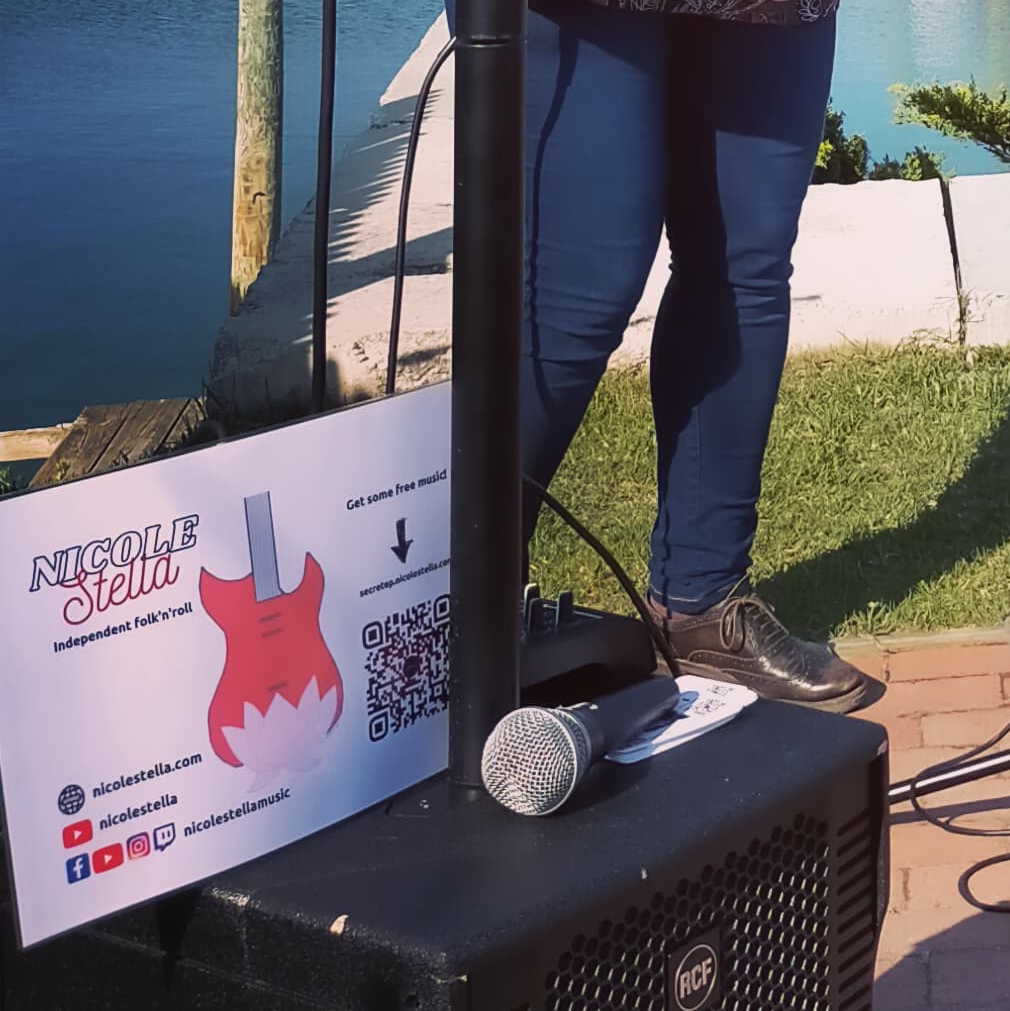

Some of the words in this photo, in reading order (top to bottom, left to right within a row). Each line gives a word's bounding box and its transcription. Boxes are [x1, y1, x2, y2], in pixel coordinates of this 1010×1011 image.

[346, 496, 365, 510] Get
[367, 489, 394, 505] some
[395, 481, 416, 496] free
[29, 514, 199, 592] NICOLE
[59, 553, 180, 626] Stella
[53, 621, 132, 653] Independent
[134, 601, 194, 629] folk'n'roll
[92, 752, 203, 798] nicolestella.com
[99, 793, 178, 830] nicolestella
[183, 787, 291, 837] nicolestellamusic
[680, 957, 713, 999] RCF
